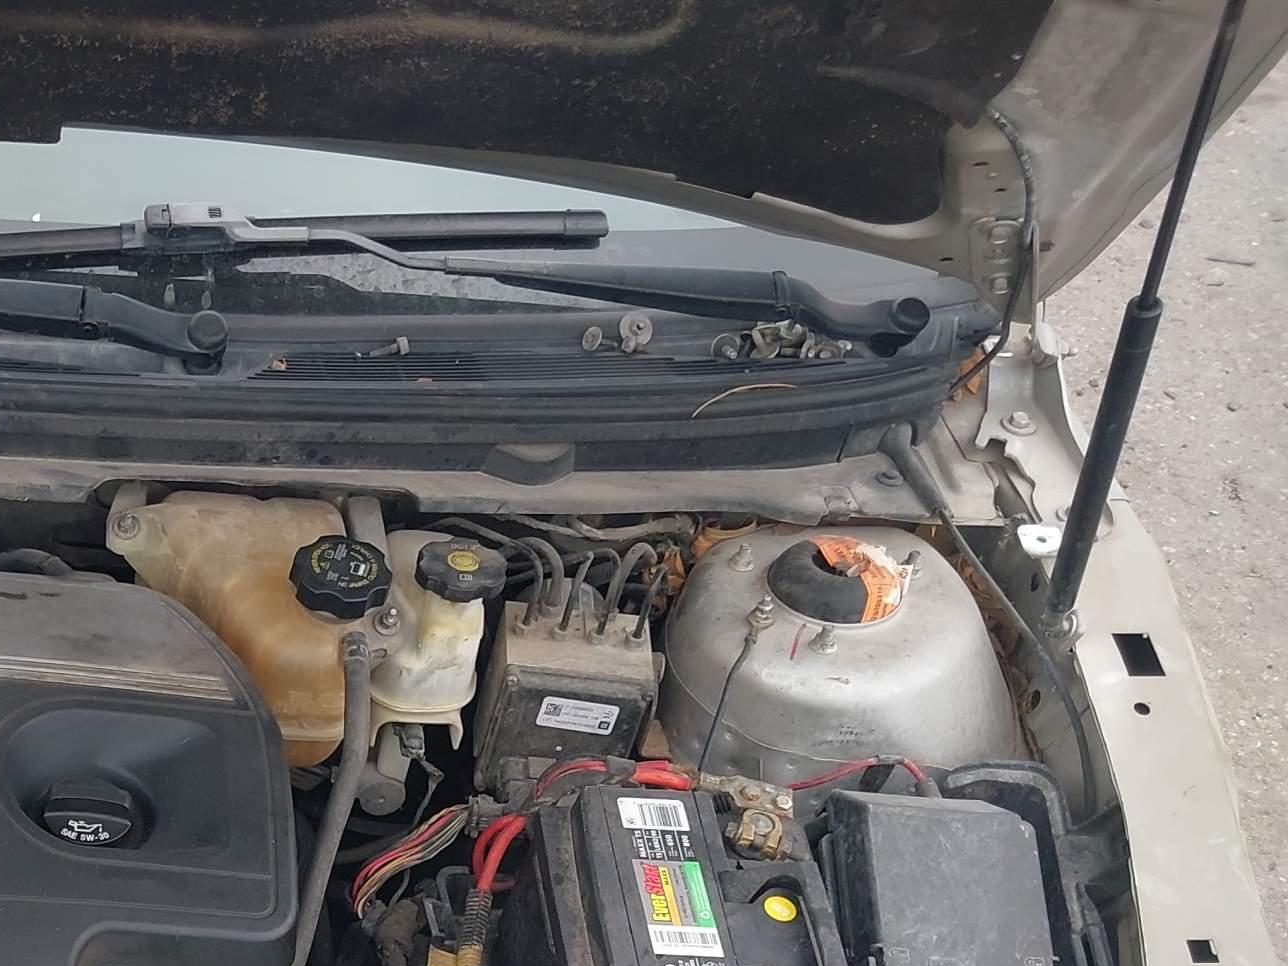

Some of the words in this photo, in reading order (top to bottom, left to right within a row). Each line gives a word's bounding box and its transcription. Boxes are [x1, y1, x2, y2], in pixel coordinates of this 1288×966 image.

[60, 828, 78, 840] SAE
[80, 832, 110, 842] 5W-30
[664, 834, 674, 846] 650
[635, 838, 647, 857] MAXX
[642, 864, 671, 921] EverStart
